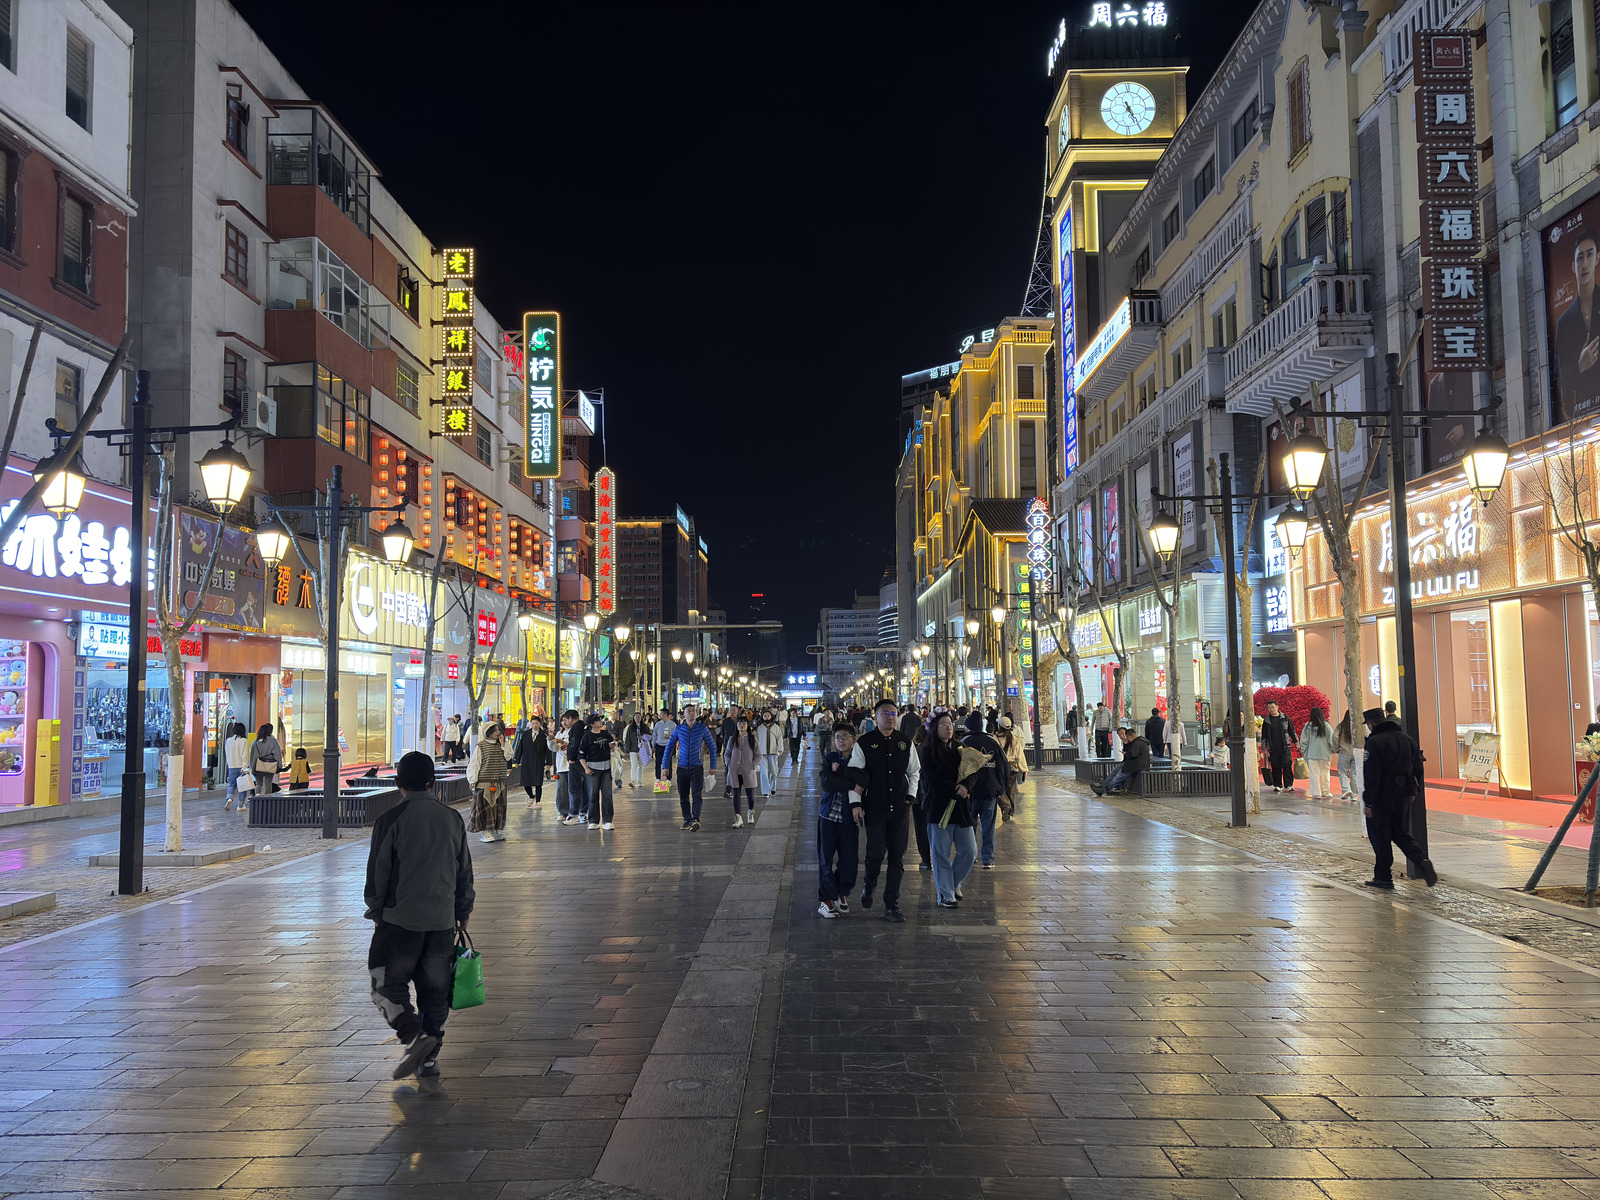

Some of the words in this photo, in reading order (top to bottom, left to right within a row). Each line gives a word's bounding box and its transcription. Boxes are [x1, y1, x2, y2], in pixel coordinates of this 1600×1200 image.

[1089, 2, 1168, 27] 周六福
[1435, 93, 1478, 358] 周六福珠宝
[530, 413, 543, 463] NINGQI
[1382, 581, 1422, 604] ZU
[1427, 575, 1451, 597] LIU
[1456, 570, 1478, 592] FU
